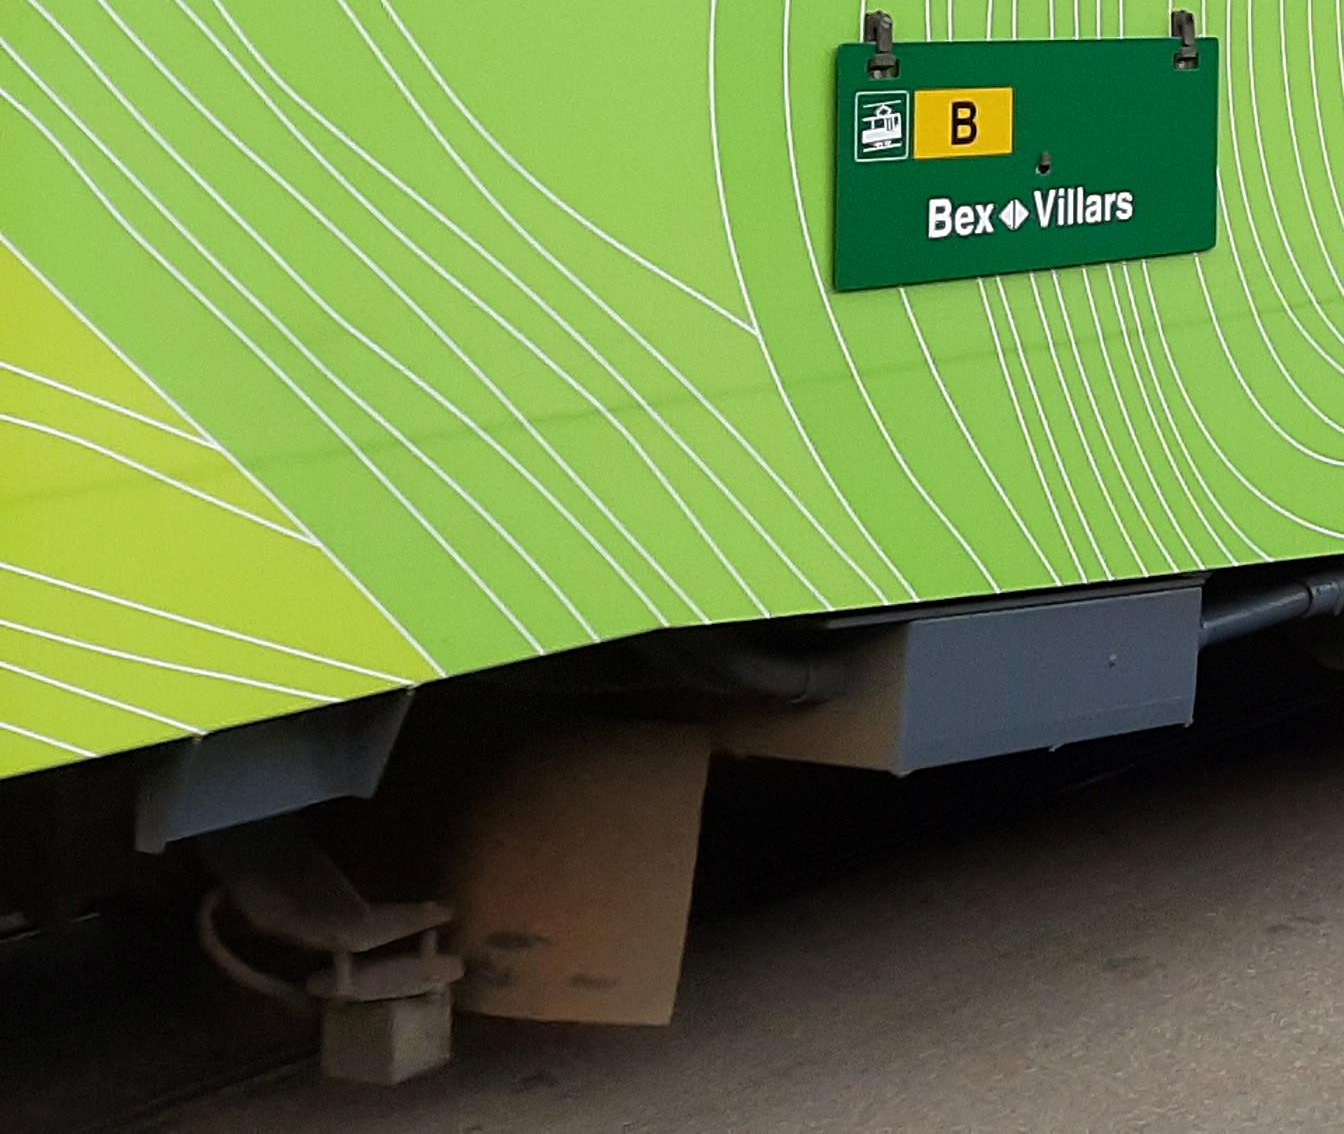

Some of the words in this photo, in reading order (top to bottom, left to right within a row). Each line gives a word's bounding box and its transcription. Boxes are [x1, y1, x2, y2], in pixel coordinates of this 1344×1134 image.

[951, 100, 978, 146] B
[928, 198, 995, 239] Bex
[1033, 186, 1134, 228] Villars
